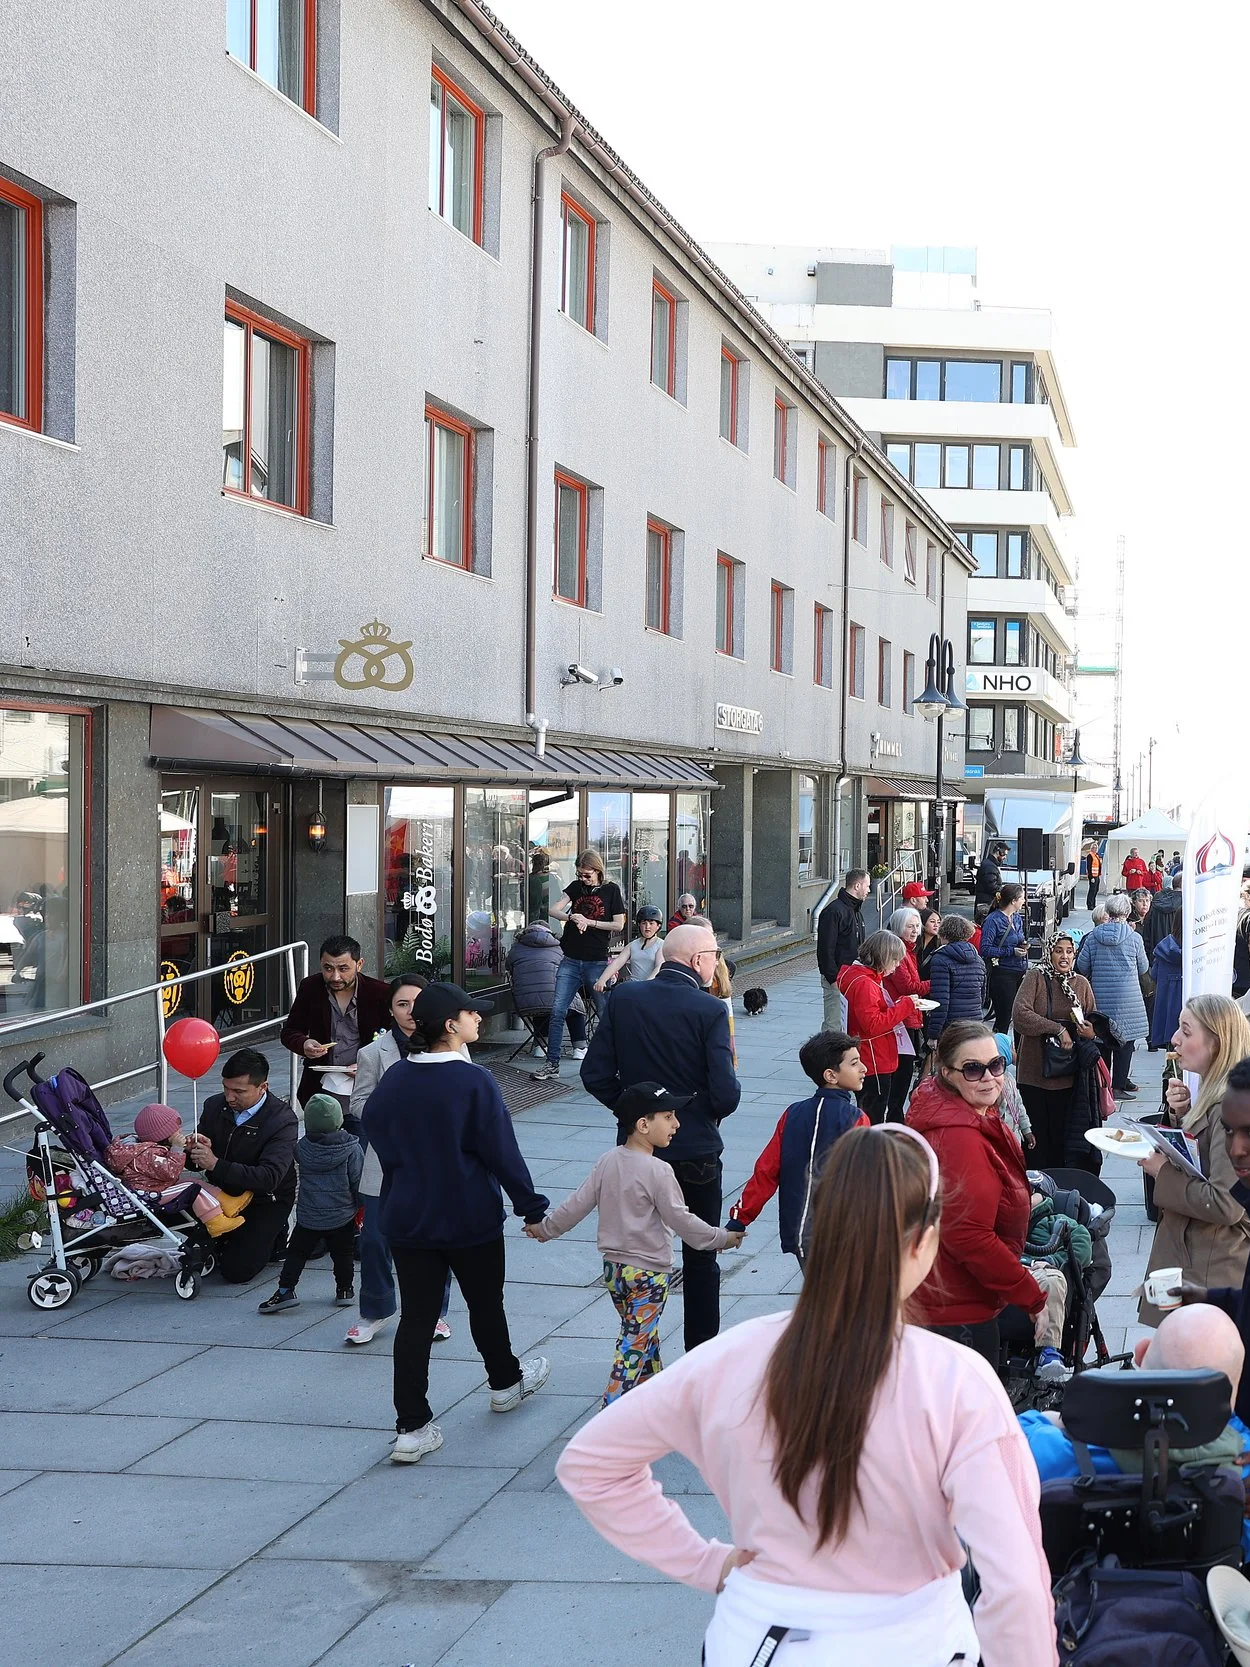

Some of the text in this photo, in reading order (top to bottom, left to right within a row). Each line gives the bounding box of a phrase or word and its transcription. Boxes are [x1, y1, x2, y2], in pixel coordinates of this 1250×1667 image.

[983, 675, 1032, 691] NHO
[721, 706, 764, 732] STORGATA 6
[415, 820, 434, 964] Bodø Bakeri
